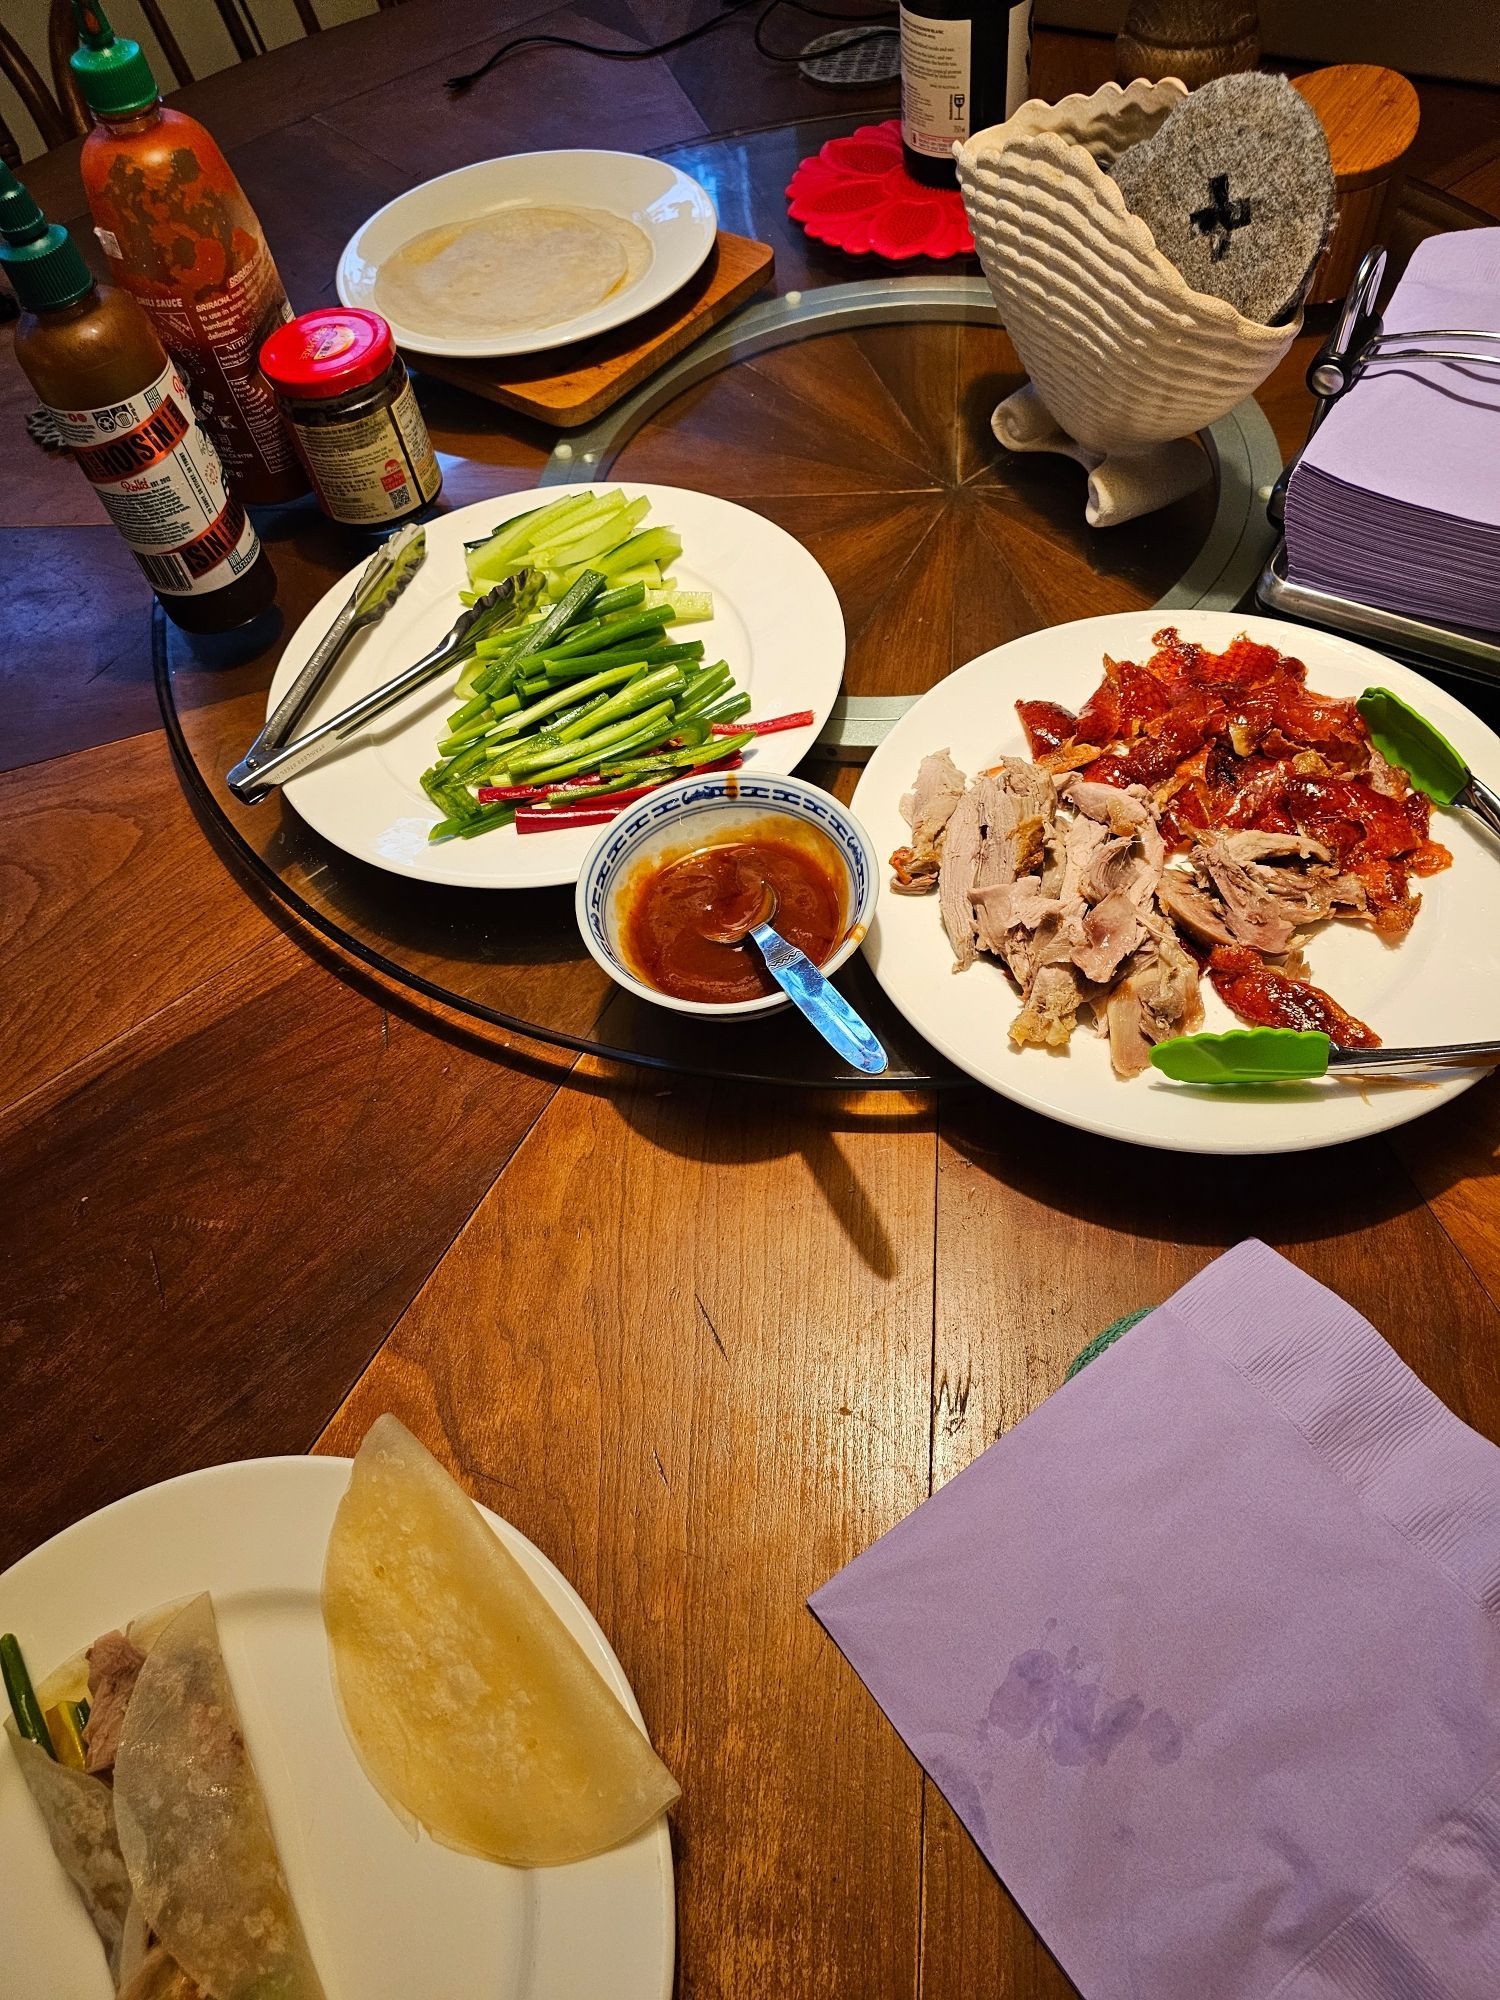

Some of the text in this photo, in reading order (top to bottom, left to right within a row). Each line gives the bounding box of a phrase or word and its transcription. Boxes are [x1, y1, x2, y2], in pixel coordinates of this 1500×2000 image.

[155, 297, 183, 308] SAUCE
[199, 315, 208, 323] to
[209, 312, 222, 321] use
[207, 328, 239, 341] delicious.
[96, 417, 175, 477] HOISIN
